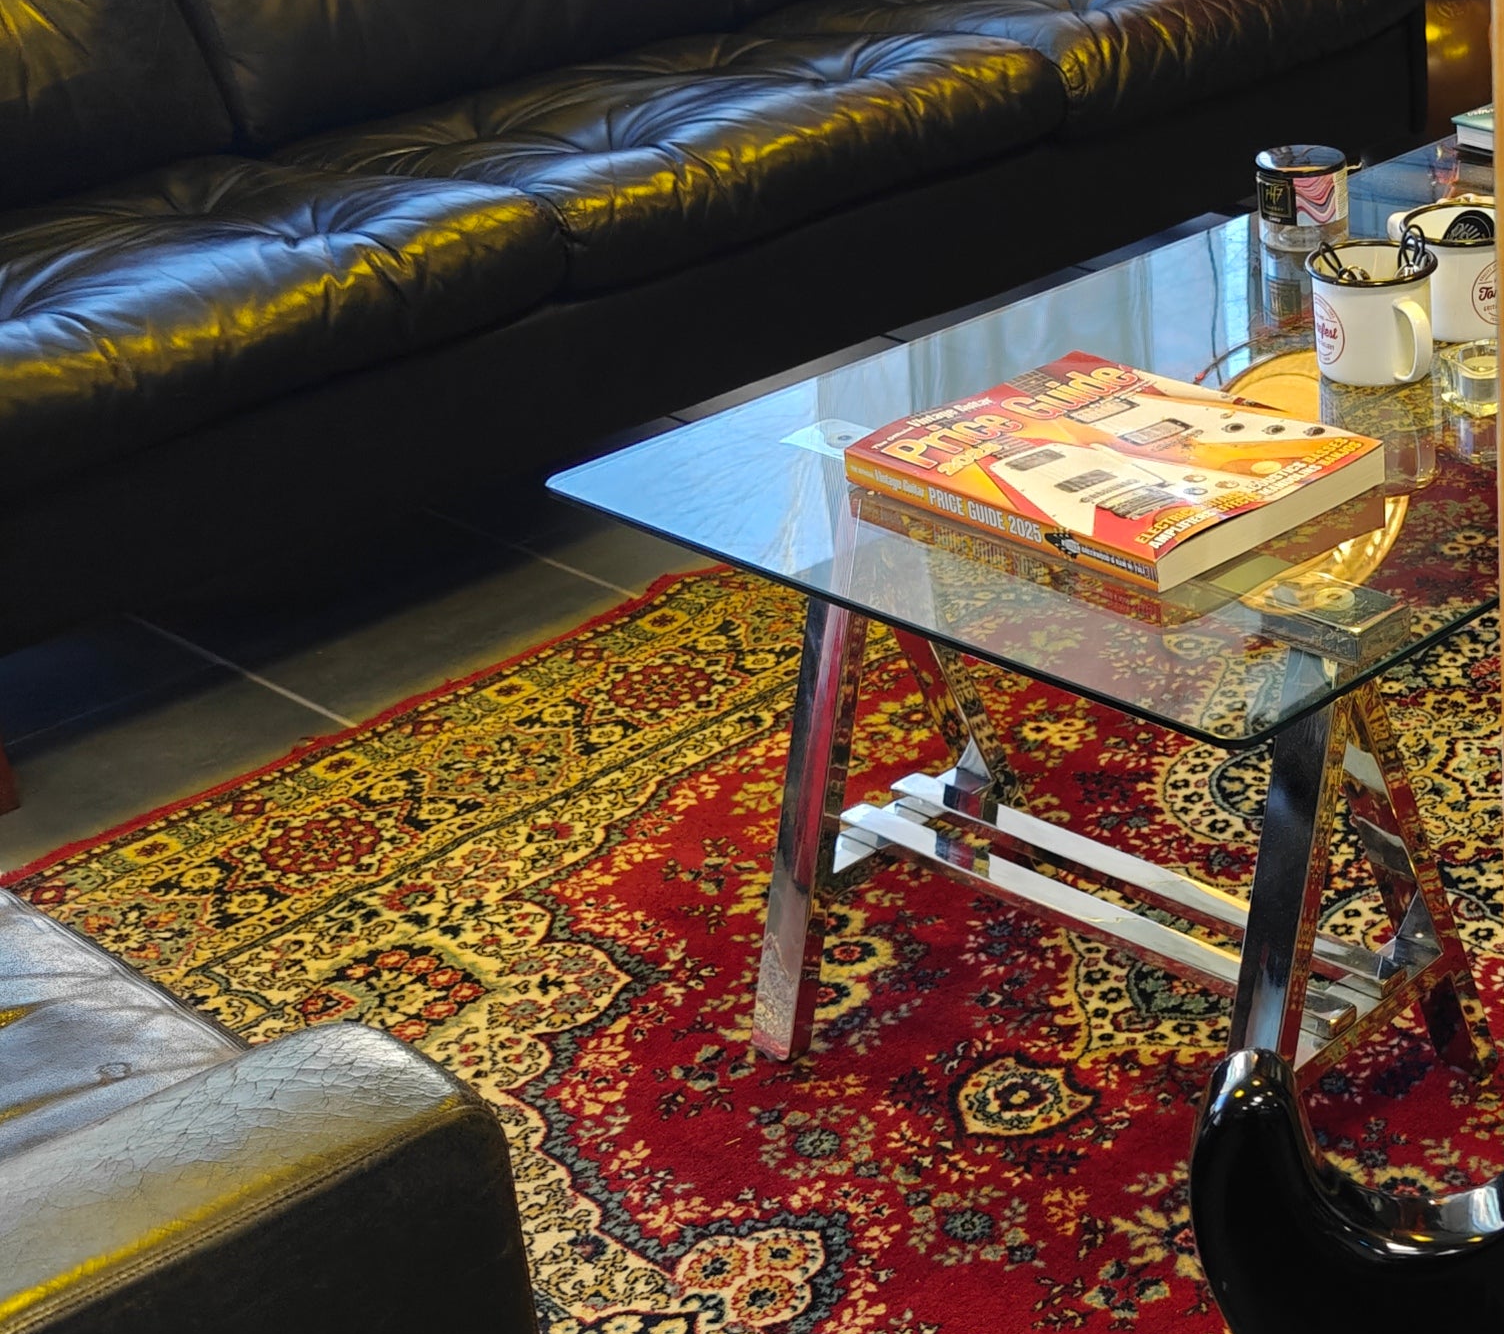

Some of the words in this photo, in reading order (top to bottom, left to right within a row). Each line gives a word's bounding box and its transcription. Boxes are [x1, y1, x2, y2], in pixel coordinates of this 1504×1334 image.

[880, 413, 1024, 471] Price
[1000, 365, 1140, 421] Guide
[906, 408, 959, 428] Vintage
[952, 397, 993, 413] Guitar
[936, 440, 1004, 477] 2025
[926, 486, 966, 517] PRICE
[966, 501, 1006, 533] GUIDE
[1007, 515, 1045, 545] 2025
[1134, 507, 1197, 544] ELECTRIC
[1301, 437, 1350, 463] BASSES
